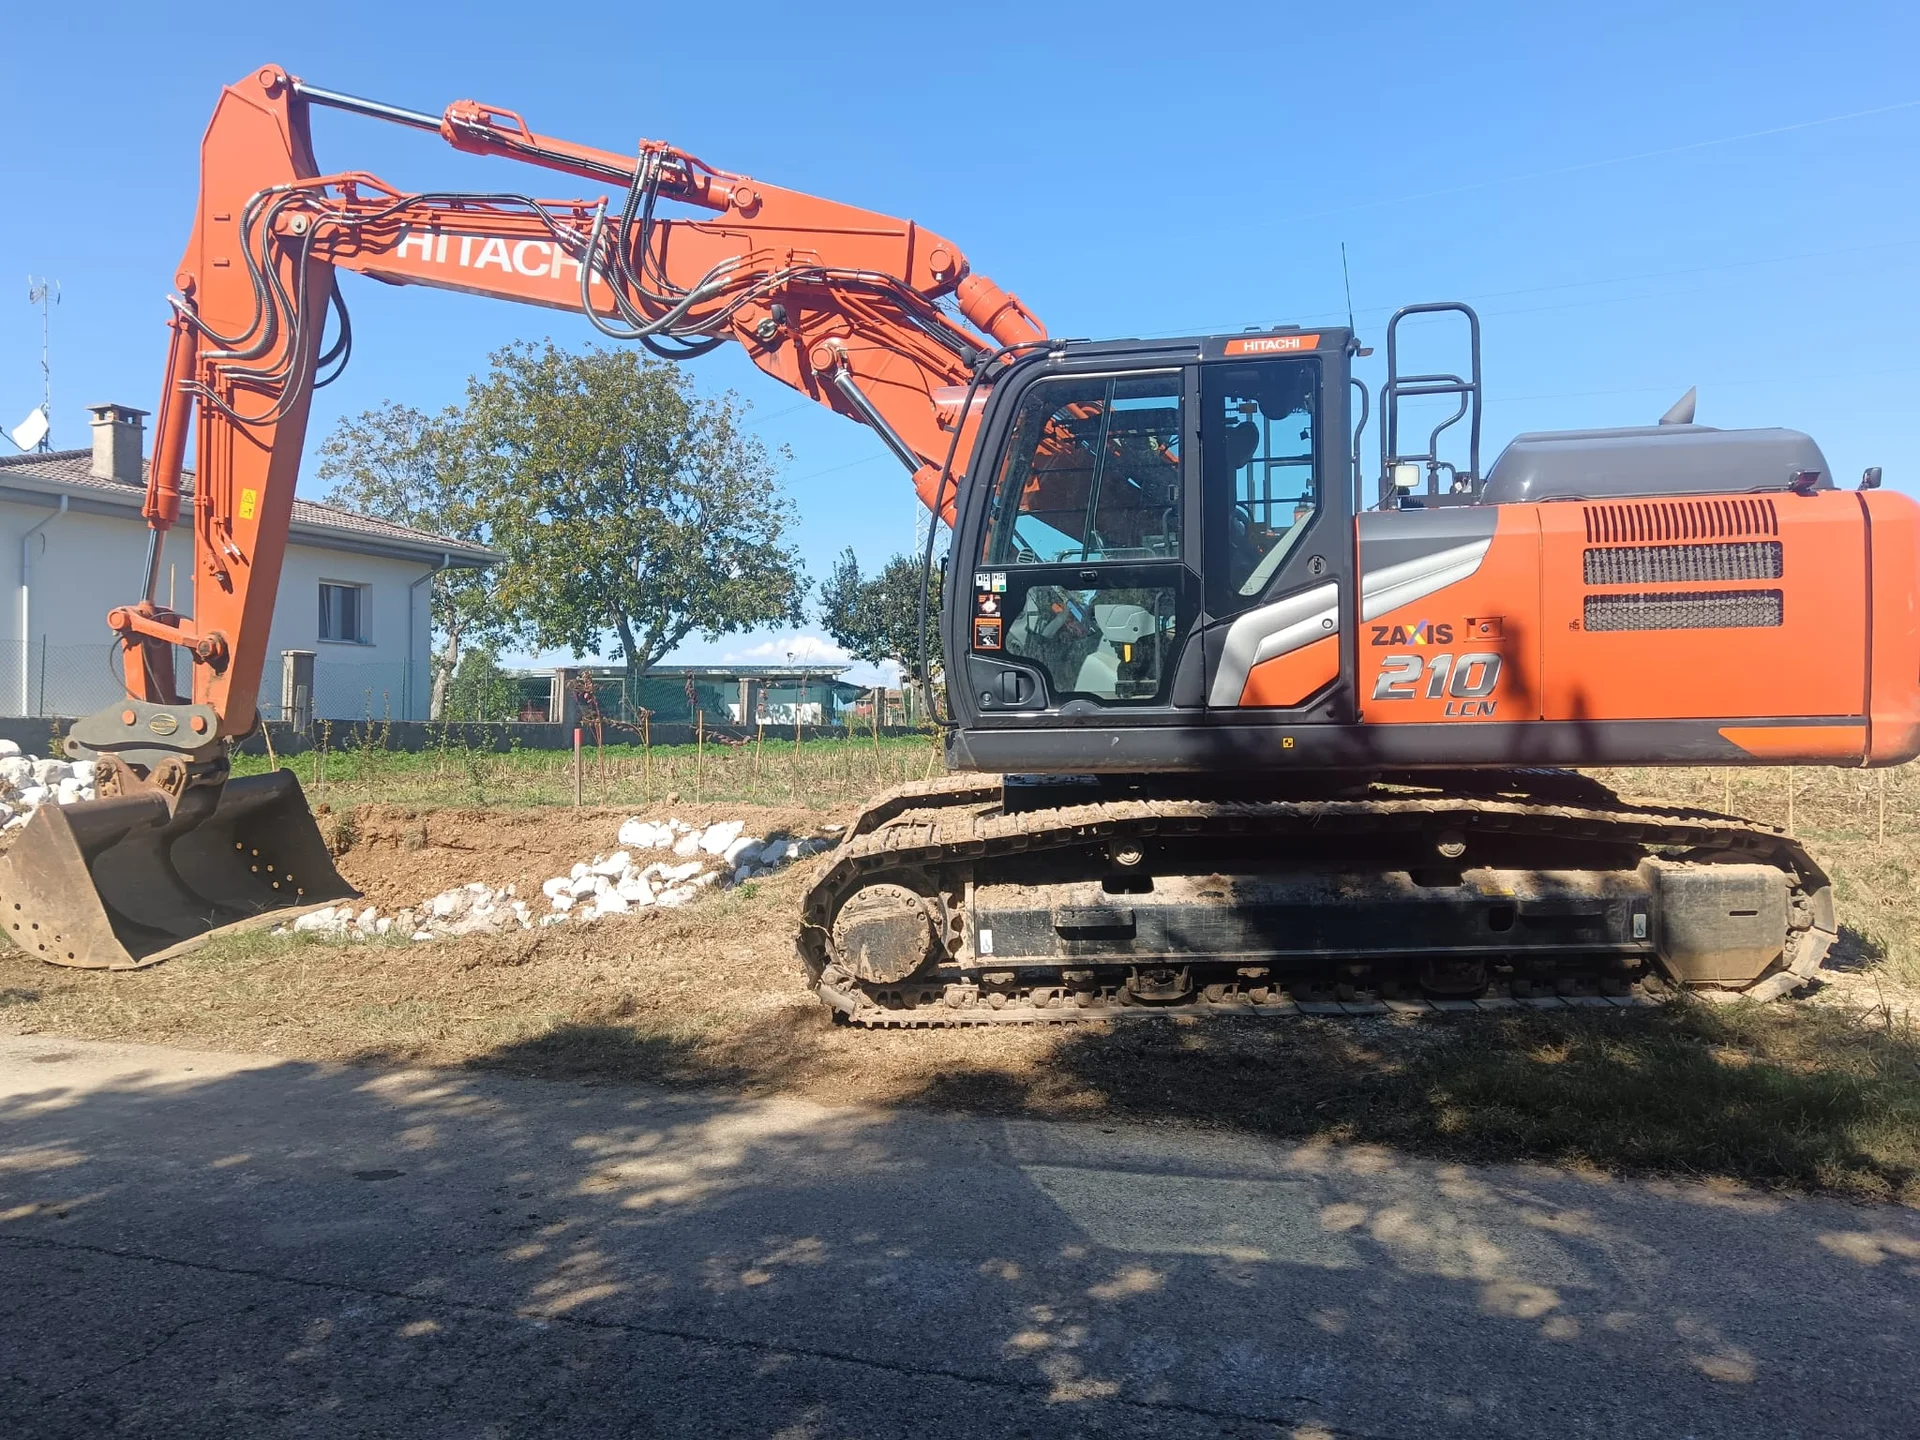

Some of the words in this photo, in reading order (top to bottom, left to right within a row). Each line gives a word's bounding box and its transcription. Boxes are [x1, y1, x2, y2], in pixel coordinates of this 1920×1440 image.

[396, 223, 602, 285] HITACH
[1243, 338, 1300, 352] HITACHI
[1371, 619, 1454, 646] ZAXIS
[1372, 652, 1504, 700] 210
[1444, 701, 1498, 717] LCN
